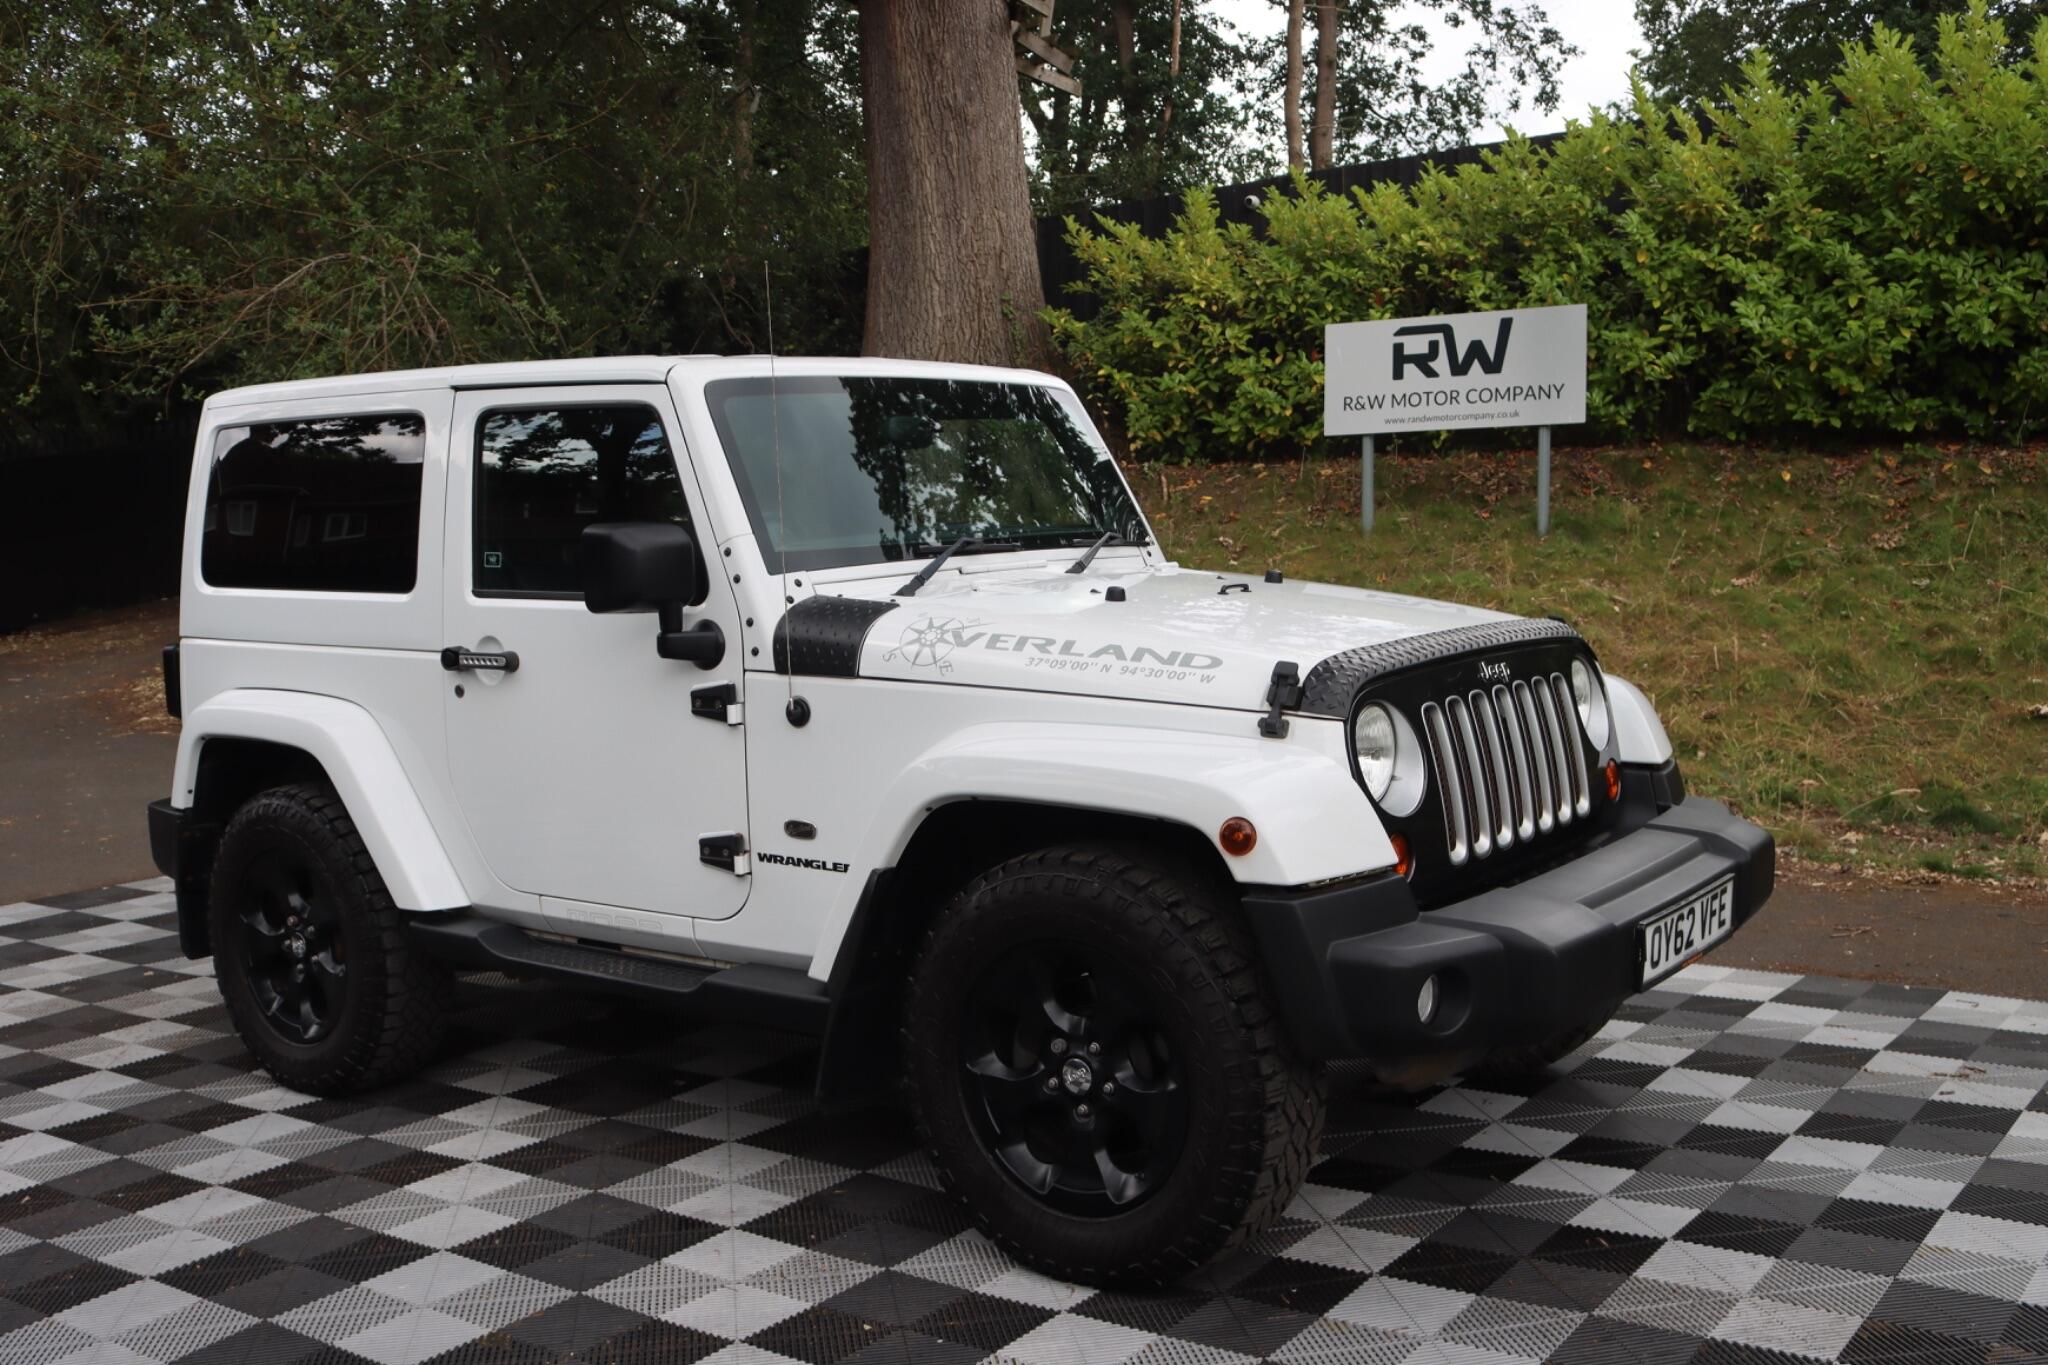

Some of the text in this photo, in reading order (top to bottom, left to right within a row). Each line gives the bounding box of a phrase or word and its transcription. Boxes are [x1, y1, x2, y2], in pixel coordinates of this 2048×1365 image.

[1343, 383, 1565, 412] R&W MOTOR COMPANY
[1384, 409, 1520, 425] www.randwmotorcompany.co.uk
[1100, 664, 1113, 674] N
[1199, 674, 1216, 684] W
[1479, 661, 1511, 684] Jeep
[1650, 886, 1728, 970] OY62 VFE
